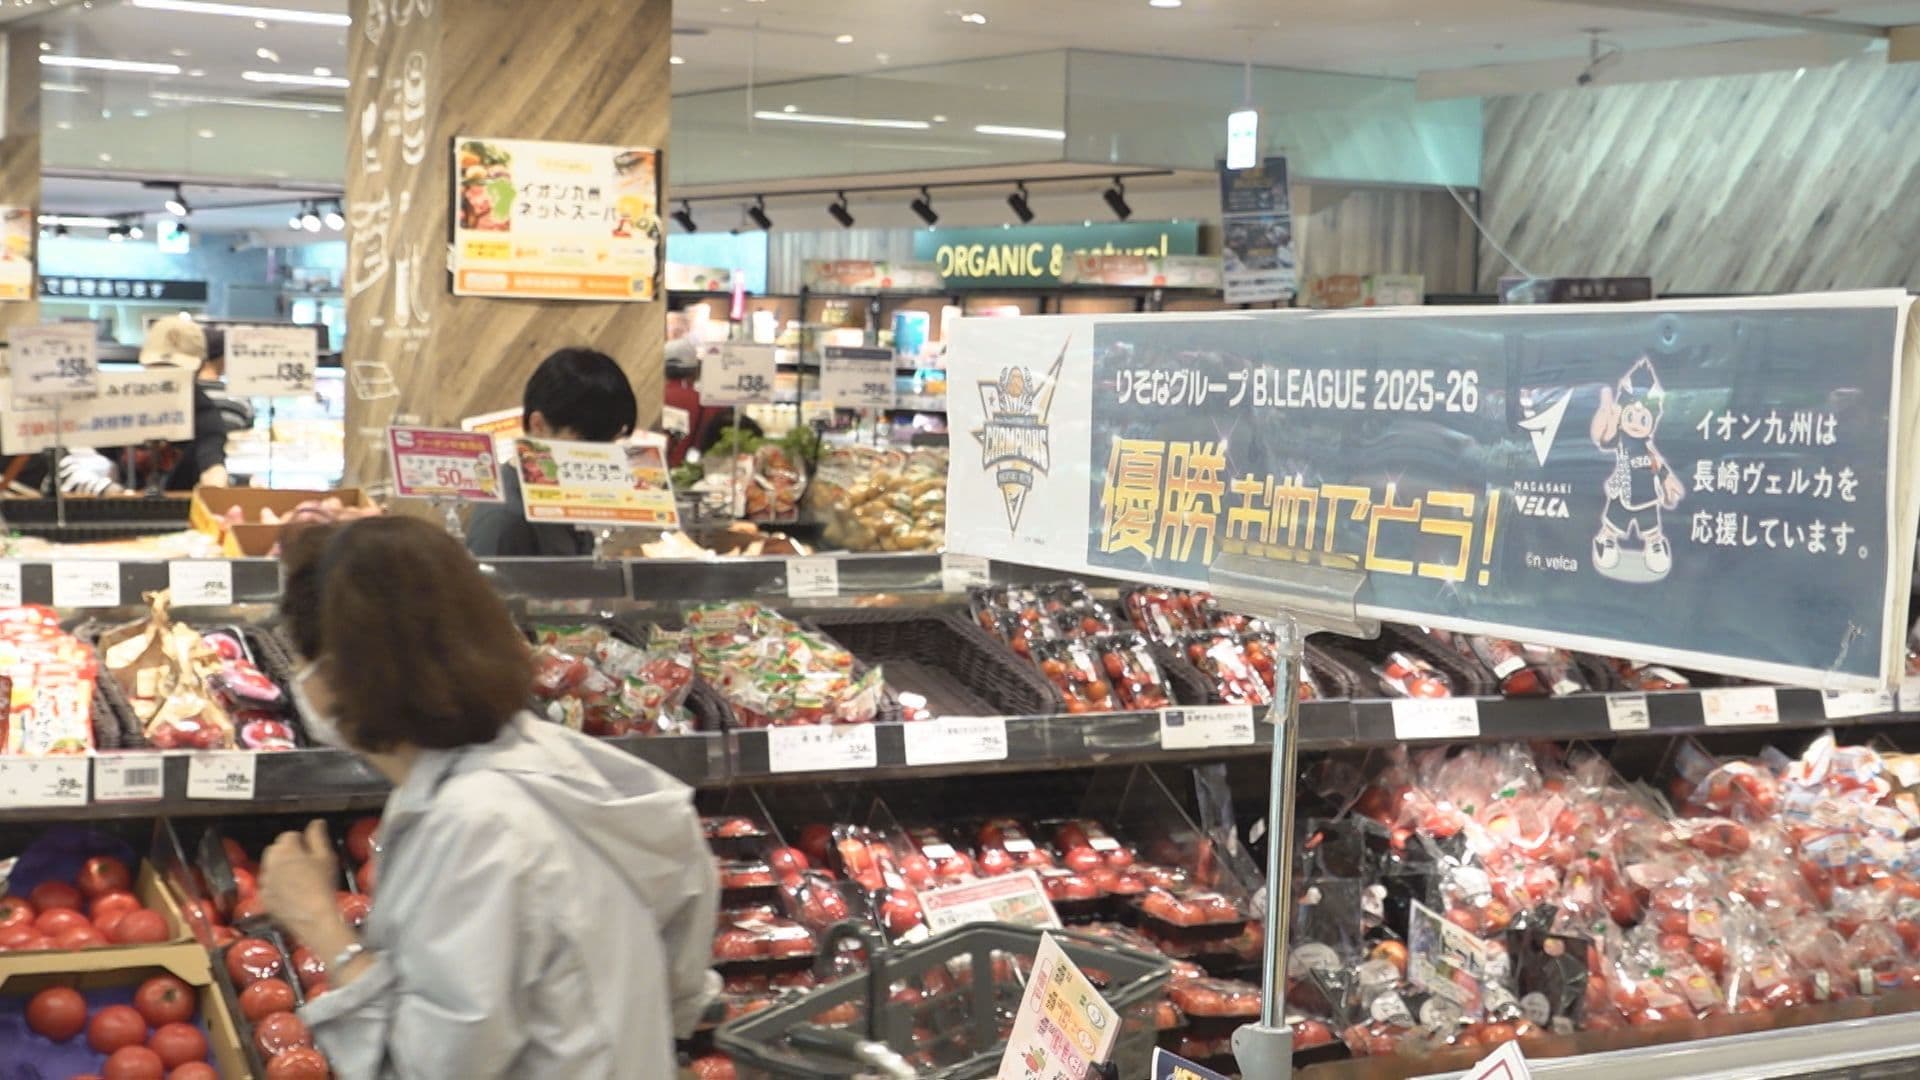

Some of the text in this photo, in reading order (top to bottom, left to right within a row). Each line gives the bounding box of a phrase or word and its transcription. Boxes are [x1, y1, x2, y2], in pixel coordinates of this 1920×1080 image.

[519, 183, 601, 202] イオン九州
[936, 243, 1044, 279] ORGANIC
[1115, 367, 1479, 413] りそなグループ B.LEAGUE 2025-26
[1696, 409, 1838, 446] イオン九州は
[984, 424, 1049, 471] CHAMPIONS
[1514, 480, 1572, 494] NAGASAKI
[1693, 459, 1859, 502] 長崎ヴェルカを
[1515, 494, 1570, 518] VELCA
[1691, 509, 1868, 560] 応援しています。
